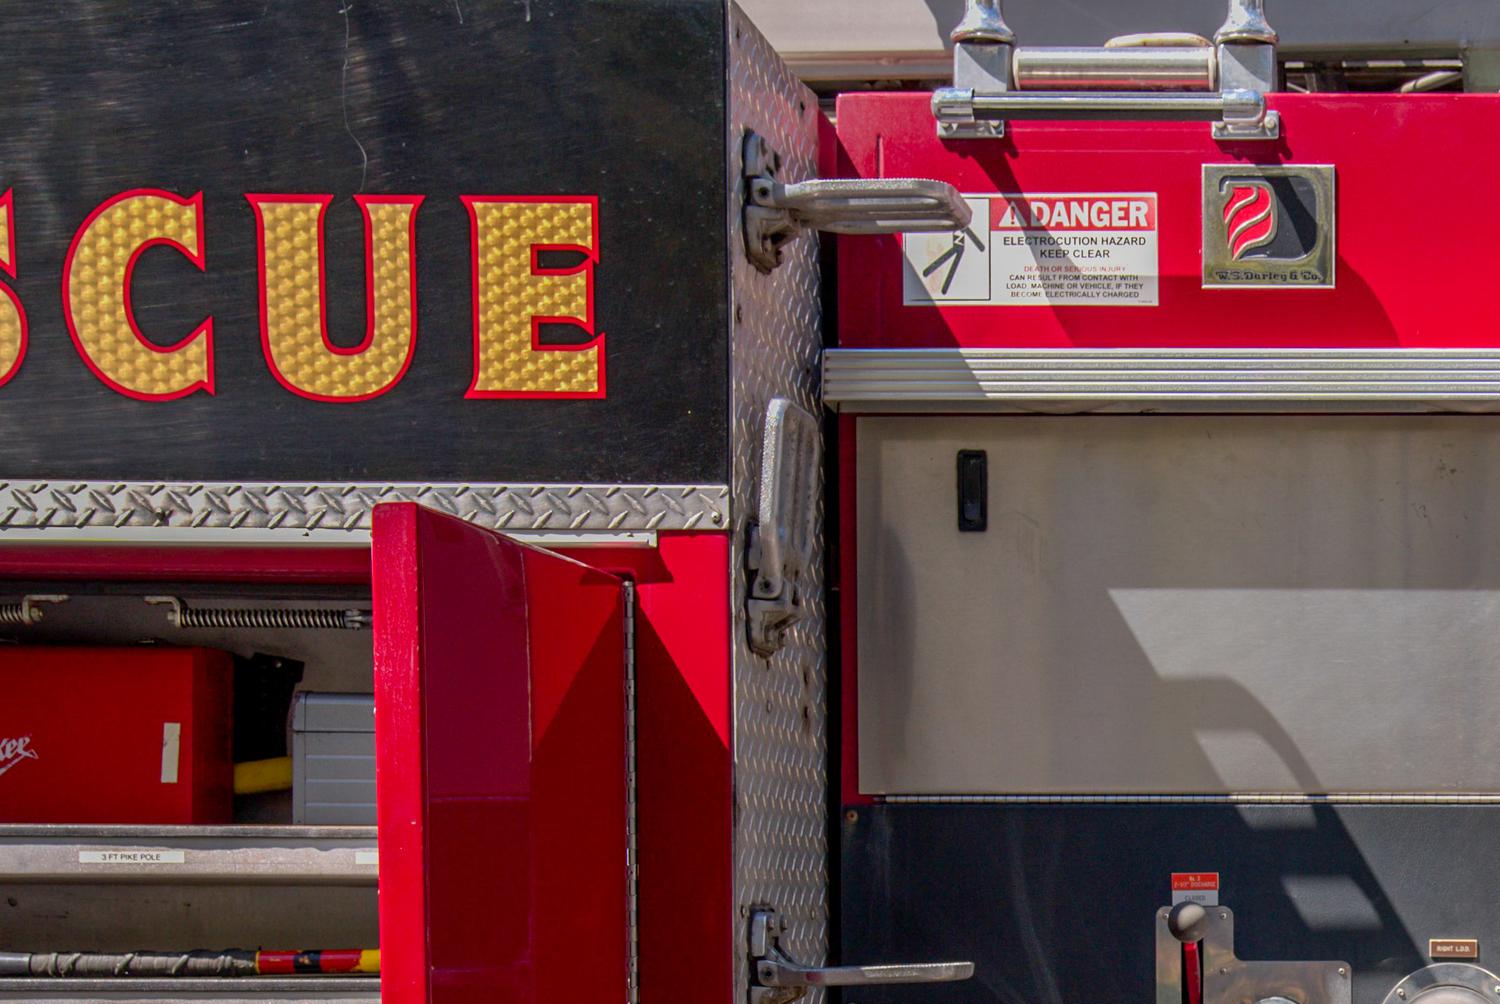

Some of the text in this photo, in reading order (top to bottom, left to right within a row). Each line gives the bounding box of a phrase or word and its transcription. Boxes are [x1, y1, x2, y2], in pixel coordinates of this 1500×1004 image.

[1031, 201, 1148, 227] DANGER
[1003, 237, 1146, 246] ELECTROCUTION HAZARD
[1040, 250, 1110, 259] KEEP CLEAR
[0, 187, 606, 402] CUE
[108, 853, 119, 861] FT
[120, 853, 138, 861] PIKE
[139, 853, 161, 861] POLE
